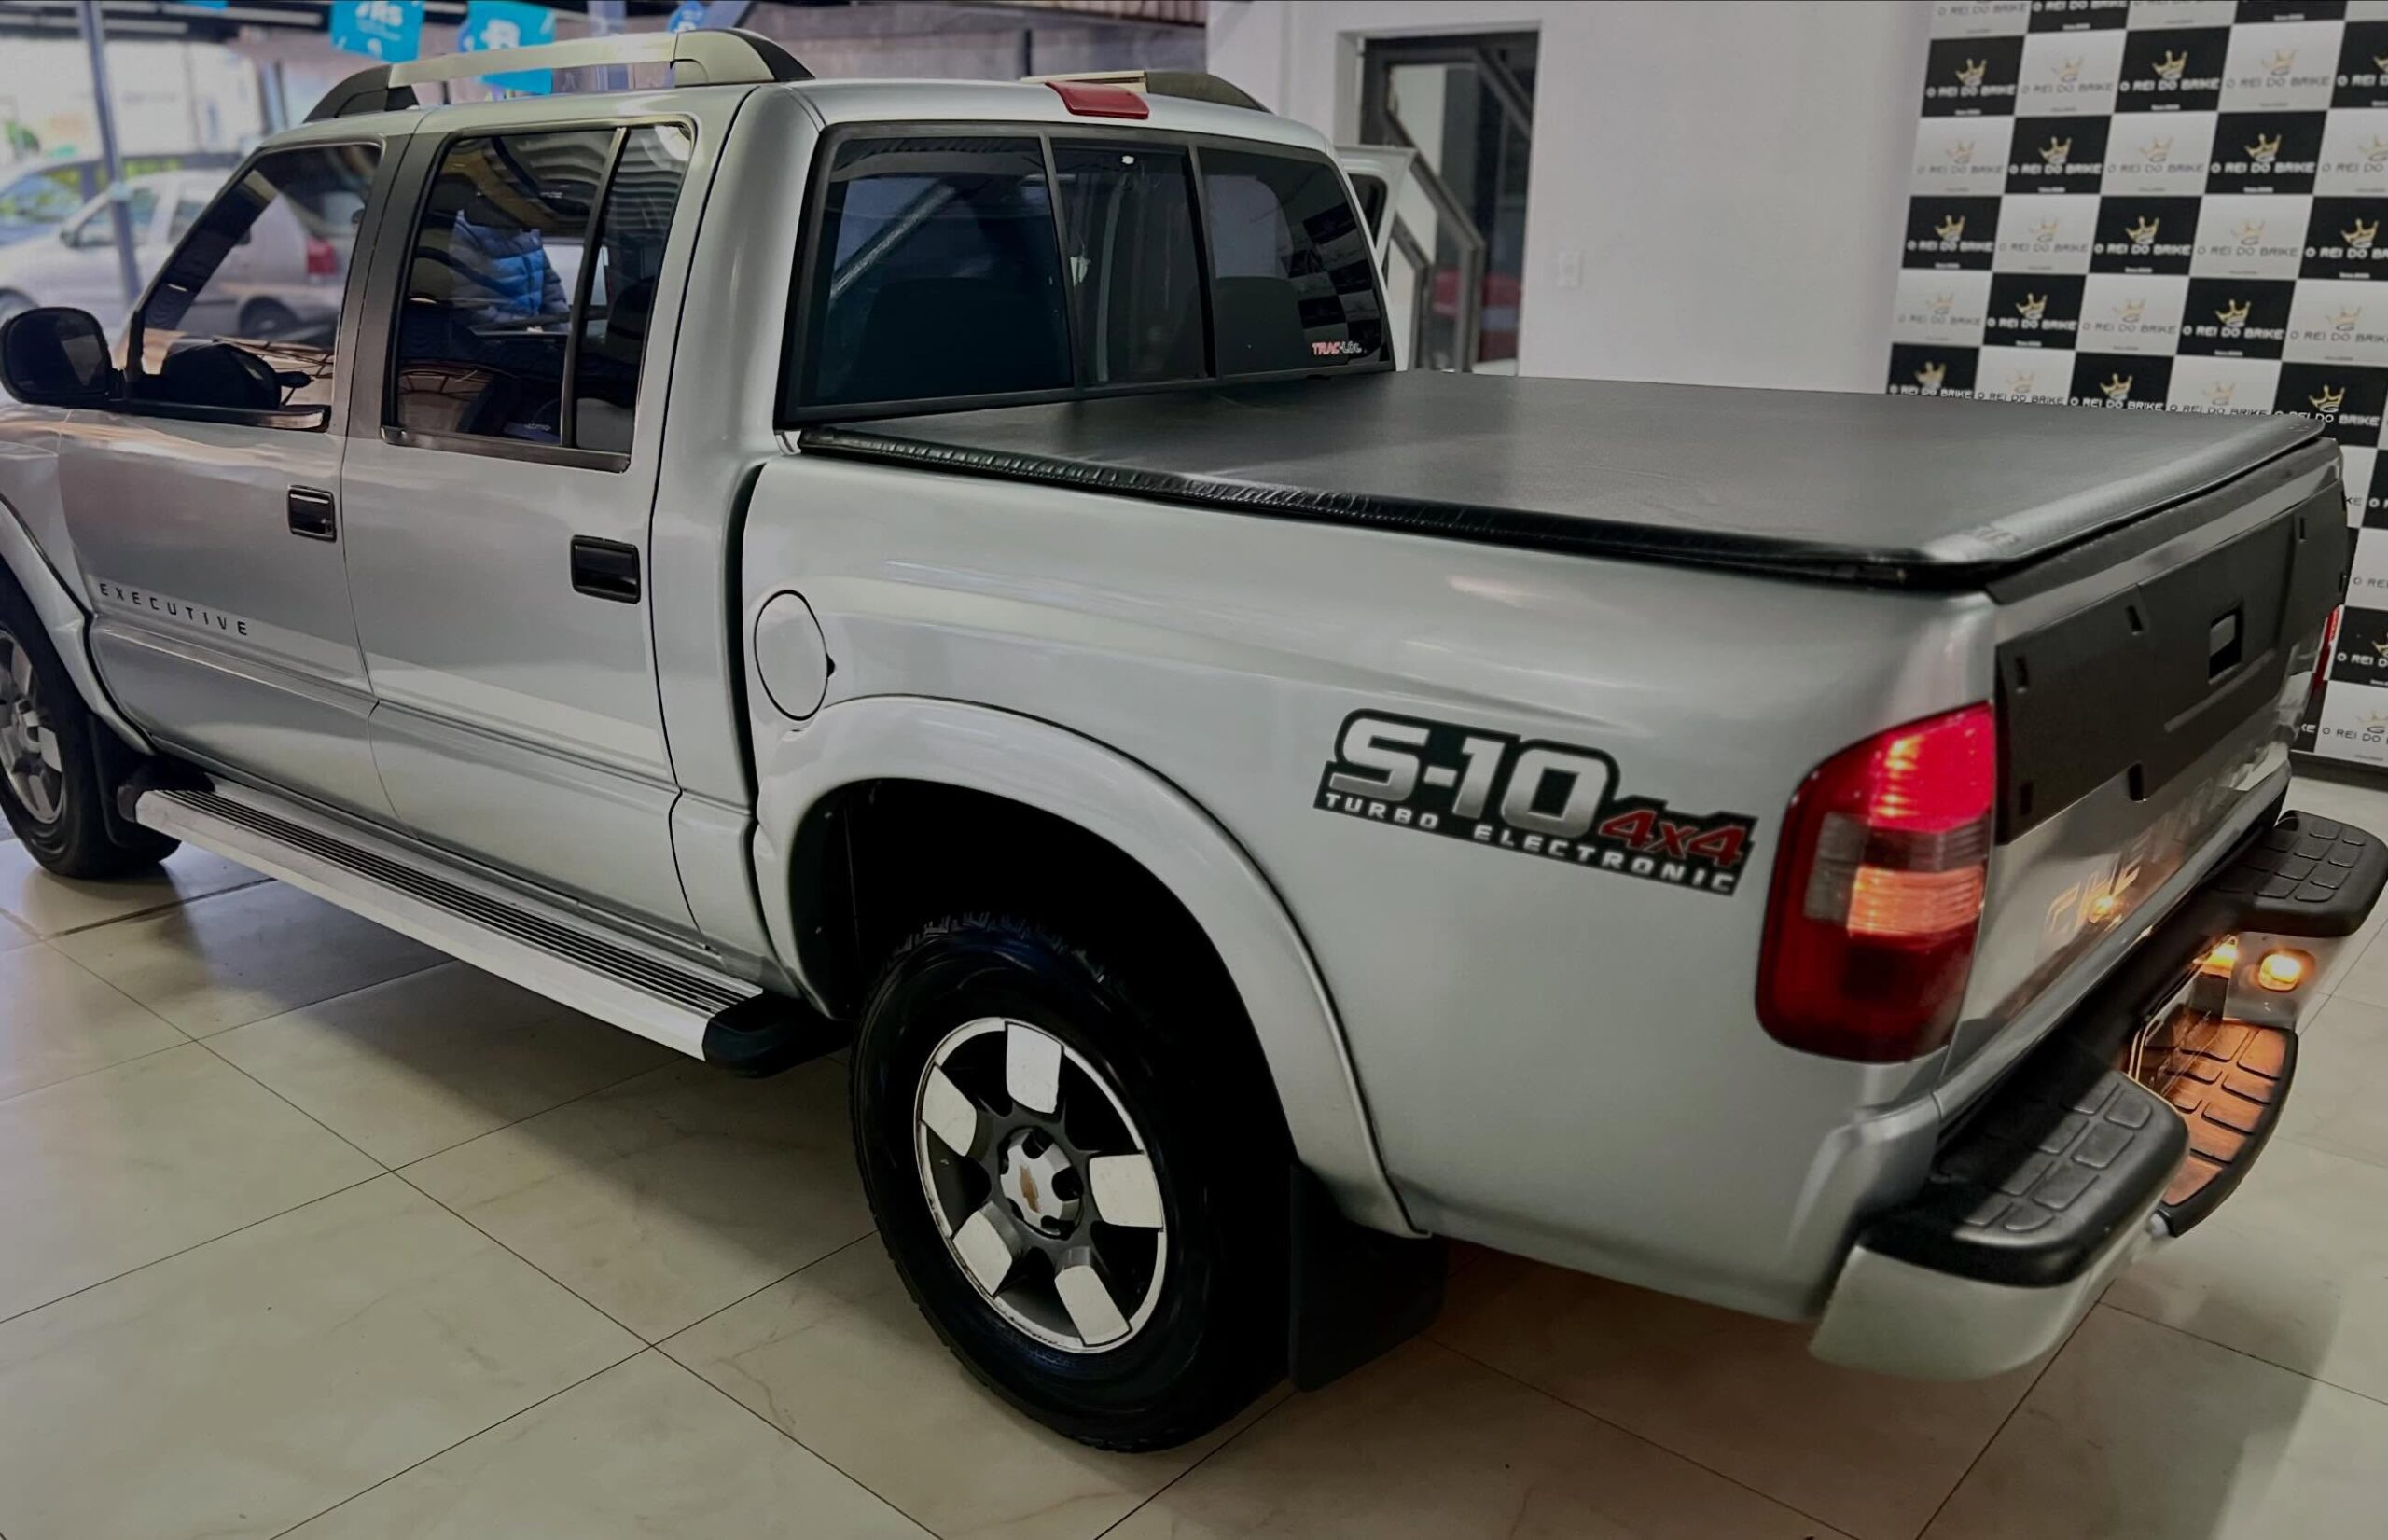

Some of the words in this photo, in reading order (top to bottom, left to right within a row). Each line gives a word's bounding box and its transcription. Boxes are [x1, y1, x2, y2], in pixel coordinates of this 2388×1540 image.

[2033, 0, 2042, 12] O
[2119, 80, 2130, 91] O
[2132, 79, 2155, 91] REI
[2157, 78, 2177, 90] DO
[2180, 77, 2220, 90] BRIKE
[2337, 75, 2349, 87] O
[2352, 74, 2377, 87] REI
[1926, 86, 1936, 98] O
[1937, 85, 1958, 98] REI
[1960, 85, 1978, 97] DO
[1980, 84, 2015, 96] BRIKE
[2008, 163, 2019, 174] O
[2020, 163, 2042, 174] REI
[2044, 163, 2062, 174] DO
[2064, 163, 2103, 174] BRIKE
[2210, 162, 2221, 173] O
[2224, 162, 2247, 173] REI
[2250, 162, 2271, 173] DO
[2274, 162, 2315, 173] BRIKE
[1907, 241, 1917, 251] O
[1918, 241, 1937, 251] REI
[1939, 241, 1957, 252] DO
[1959, 241, 1993, 252] BRIKE
[2093, 243, 2104, 255] O
[2106, 243, 2129, 255] REI
[2131, 243, 2150, 255] DO
[2153, 243, 2191, 255] BRIKE
[2305, 246, 2316, 258] O
[2319, 246, 2344, 259] REI
[2346, 247, 2368, 259] DO
[1986, 317, 1996, 327] O
[1998, 317, 2019, 328] REI
[2020, 318, 2038, 329] DO
[2041, 319, 2077, 331] BRIKE
[2182, 325, 2192, 336] O
[2194, 325, 2218, 337] REI
[2220, 326, 2241, 338] DO
[2242, 326, 2284, 340] BRIKE
[2290, 331, 2299, 340] O
[2304, 331, 2326, 341] REI
[2330, 332, 2351, 342] DO
[1889, 383, 1898, 394] O
[1900, 384, 1919, 395] REI
[1921, 385, 1937, 396] DO
[1939, 387, 1973, 399] BRIKE
[1977, 391, 1985, 400] O
[1989, 392, 2006, 402] REI
[2011, 393, 2027, 403] DO
[2031, 395, 2065, 405] BRIKE
[2070, 396, 2079, 407] O
[2082, 397, 2103, 408] REI
[2105, 398, 2124, 409] DO
[2127, 400, 2164, 411] BRIKE
[2170, 403, 2177, 412] O
[2207, 405, 2225, 415] DO
[2339, 414, 2381, 426] BRIKE
[2369, 496, 2381, 508] O
[2353, 577, 2362, 586] O
[99, 583, 247, 636] EXECUTIVE
[2337, 652, 2347, 662] O
[2351, 654, 2374, 666] REI
[2337, 728, 2357, 740] REI
[2362, 733, 2381, 743] DO
[1328, 717, 1609, 839] S-10
[1598, 809, 1748, 867] 4x4
[1325, 792, 1439, 829] TURBO
[1473, 824, 1735, 893] ELECTRONIC
